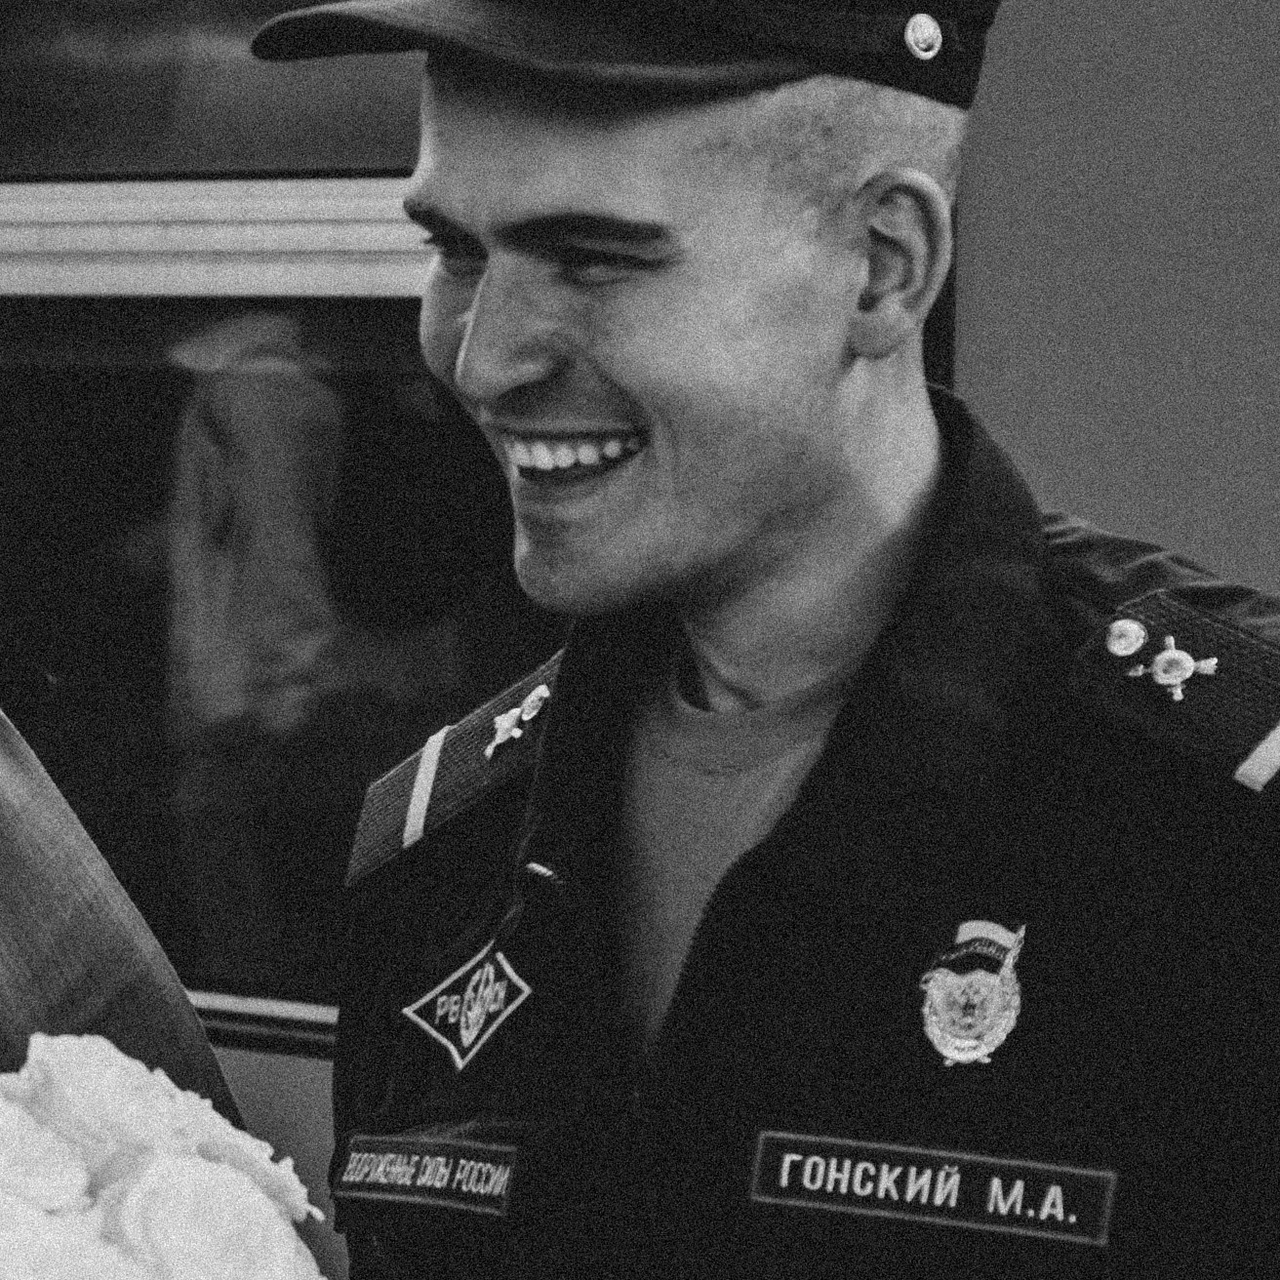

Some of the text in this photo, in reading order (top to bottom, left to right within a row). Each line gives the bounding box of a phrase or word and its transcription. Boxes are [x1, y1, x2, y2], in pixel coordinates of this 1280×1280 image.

[452, 1158, 511, 1196] РОССИИ
[779, 1152, 1077, 1223] ГОНСКИЙ М.А.
